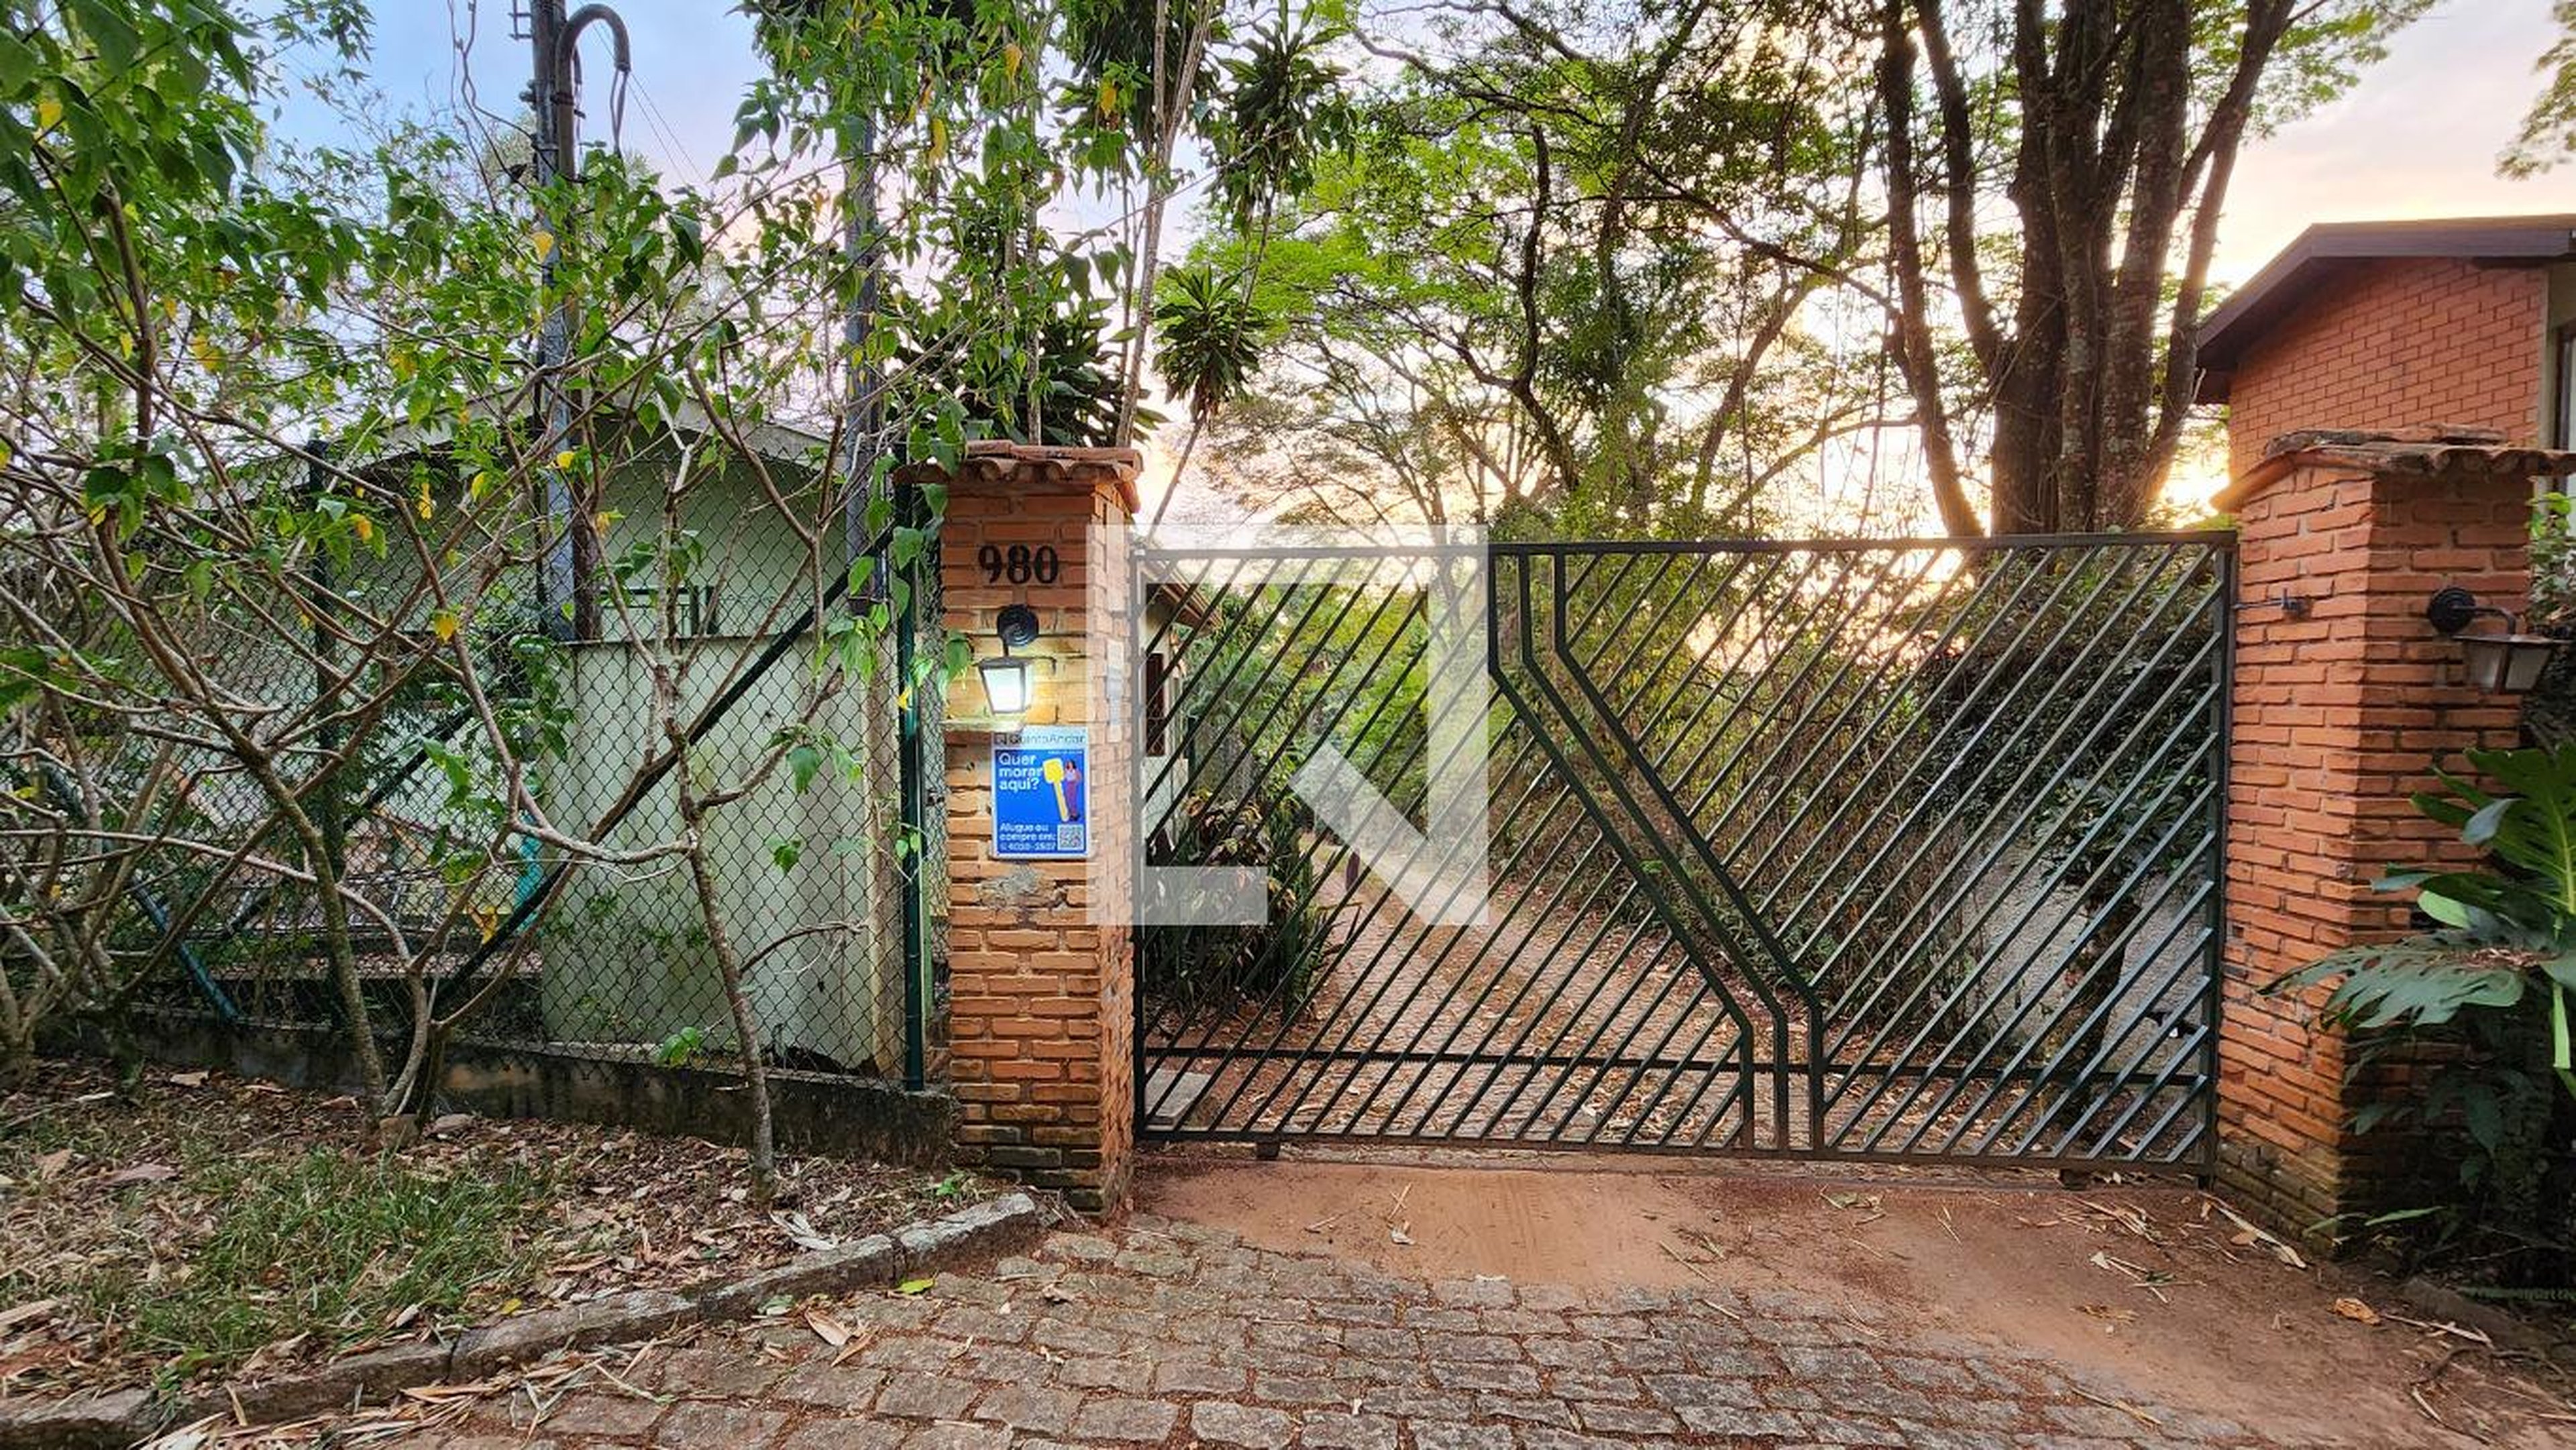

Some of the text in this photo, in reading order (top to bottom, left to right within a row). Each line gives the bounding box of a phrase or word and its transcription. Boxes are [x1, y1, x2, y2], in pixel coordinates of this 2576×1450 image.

[978, 545, 1059, 584] 980
[999, 752, 1036, 766] Quer
[999, 767, 1044, 777] morar
[999, 778, 1040, 793] aqui?
[1000, 823, 1034, 833] Alugue
[1000, 833, 1037, 842] compre
